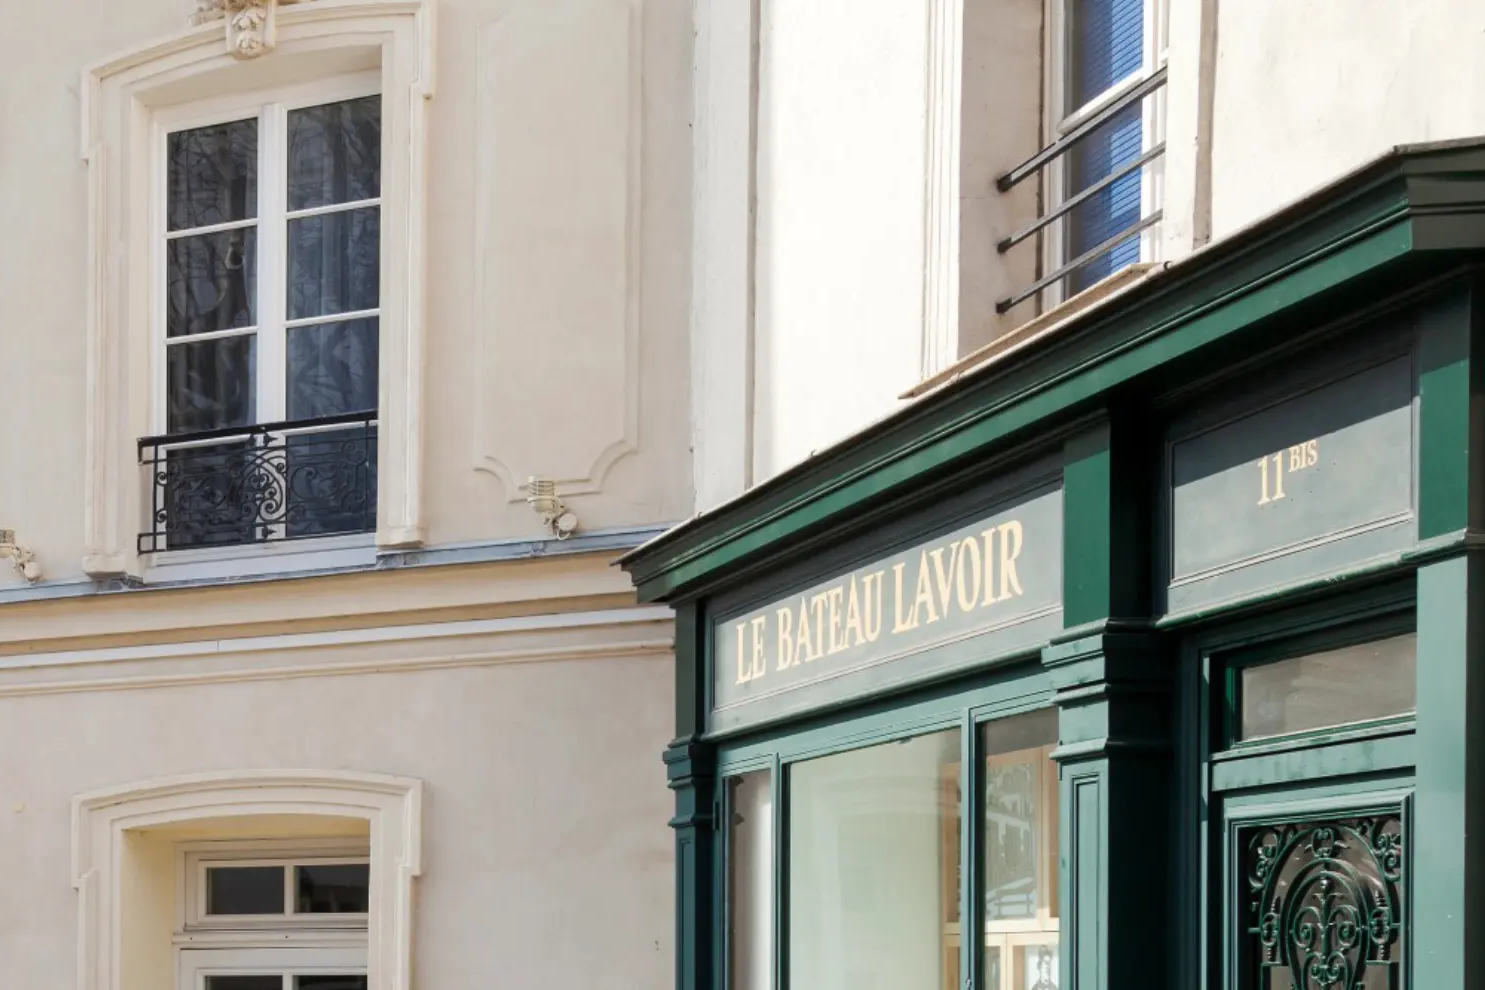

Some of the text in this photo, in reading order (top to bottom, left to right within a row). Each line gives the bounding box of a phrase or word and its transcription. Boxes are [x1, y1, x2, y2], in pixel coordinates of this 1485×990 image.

[1257, 439, 1318, 505] 11 BIS
[734, 518, 1024, 686] LE BATEAU LAVOIR
